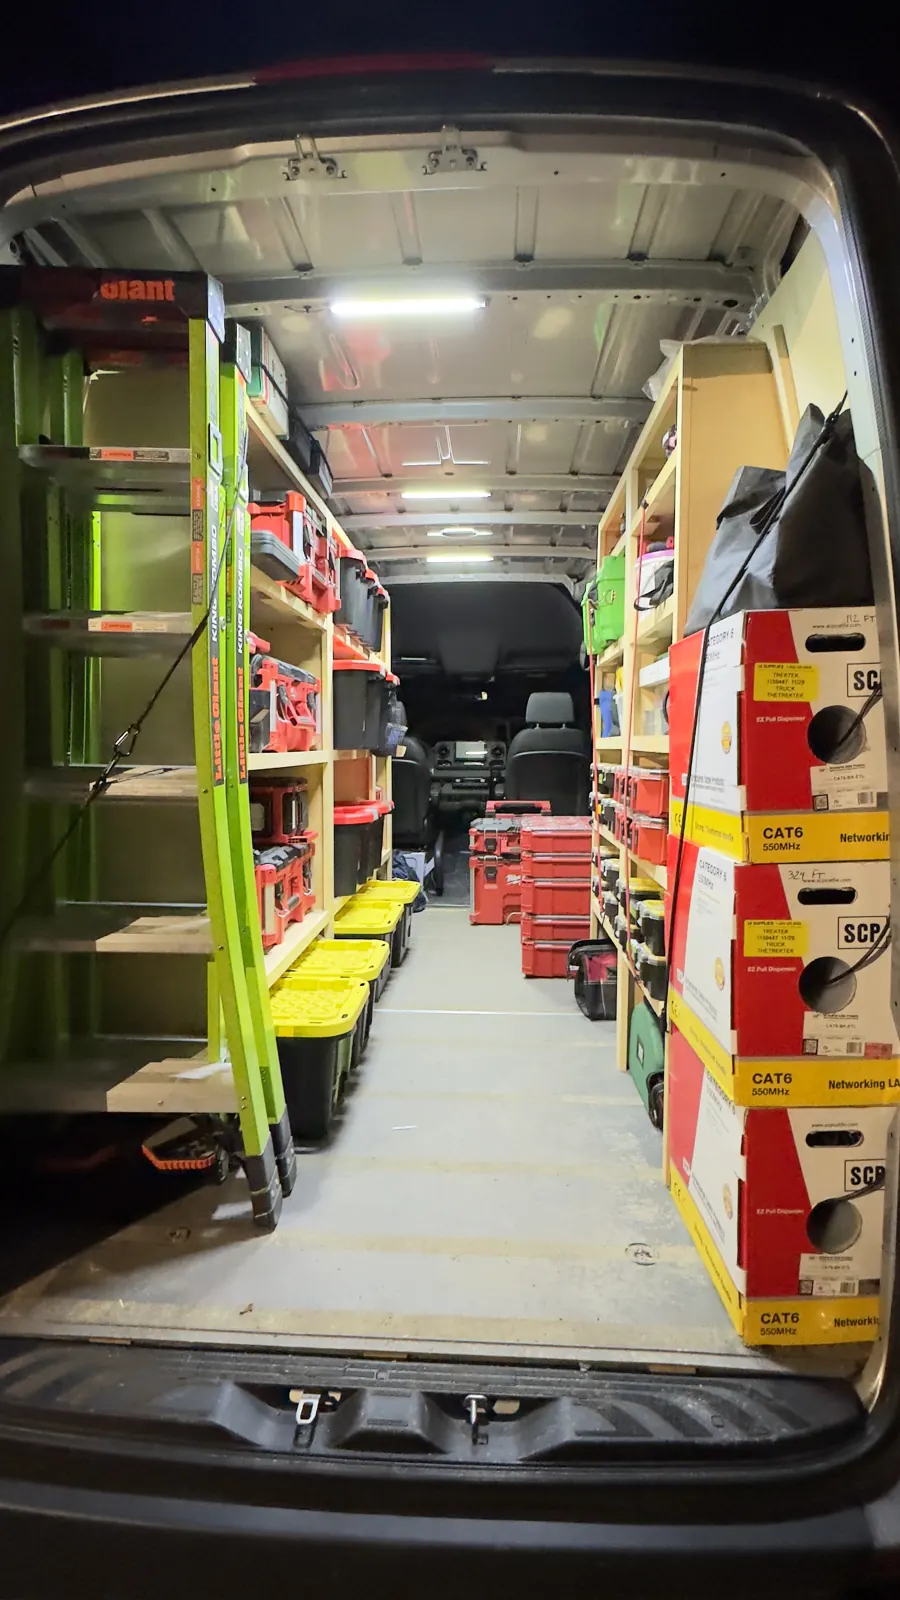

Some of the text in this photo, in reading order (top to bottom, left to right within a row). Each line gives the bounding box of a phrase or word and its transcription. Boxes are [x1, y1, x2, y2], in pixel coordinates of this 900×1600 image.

[101, 279, 175, 301] Giant
[853, 670, 882, 691] SC
[763, 827, 803, 839] CAT6
[840, 832, 890, 843] Networkin
[763, 842, 800, 851] 550MHz
[844, 923, 880, 943] SCP
[752, 1073, 792, 1084] CAT6
[828, 1079, 885, 1090] Networking
[752, 1087, 790, 1096] 550MHz
[760, 1312, 800, 1324] CAT6
[760, 1327, 797, 1336] 550MHz
